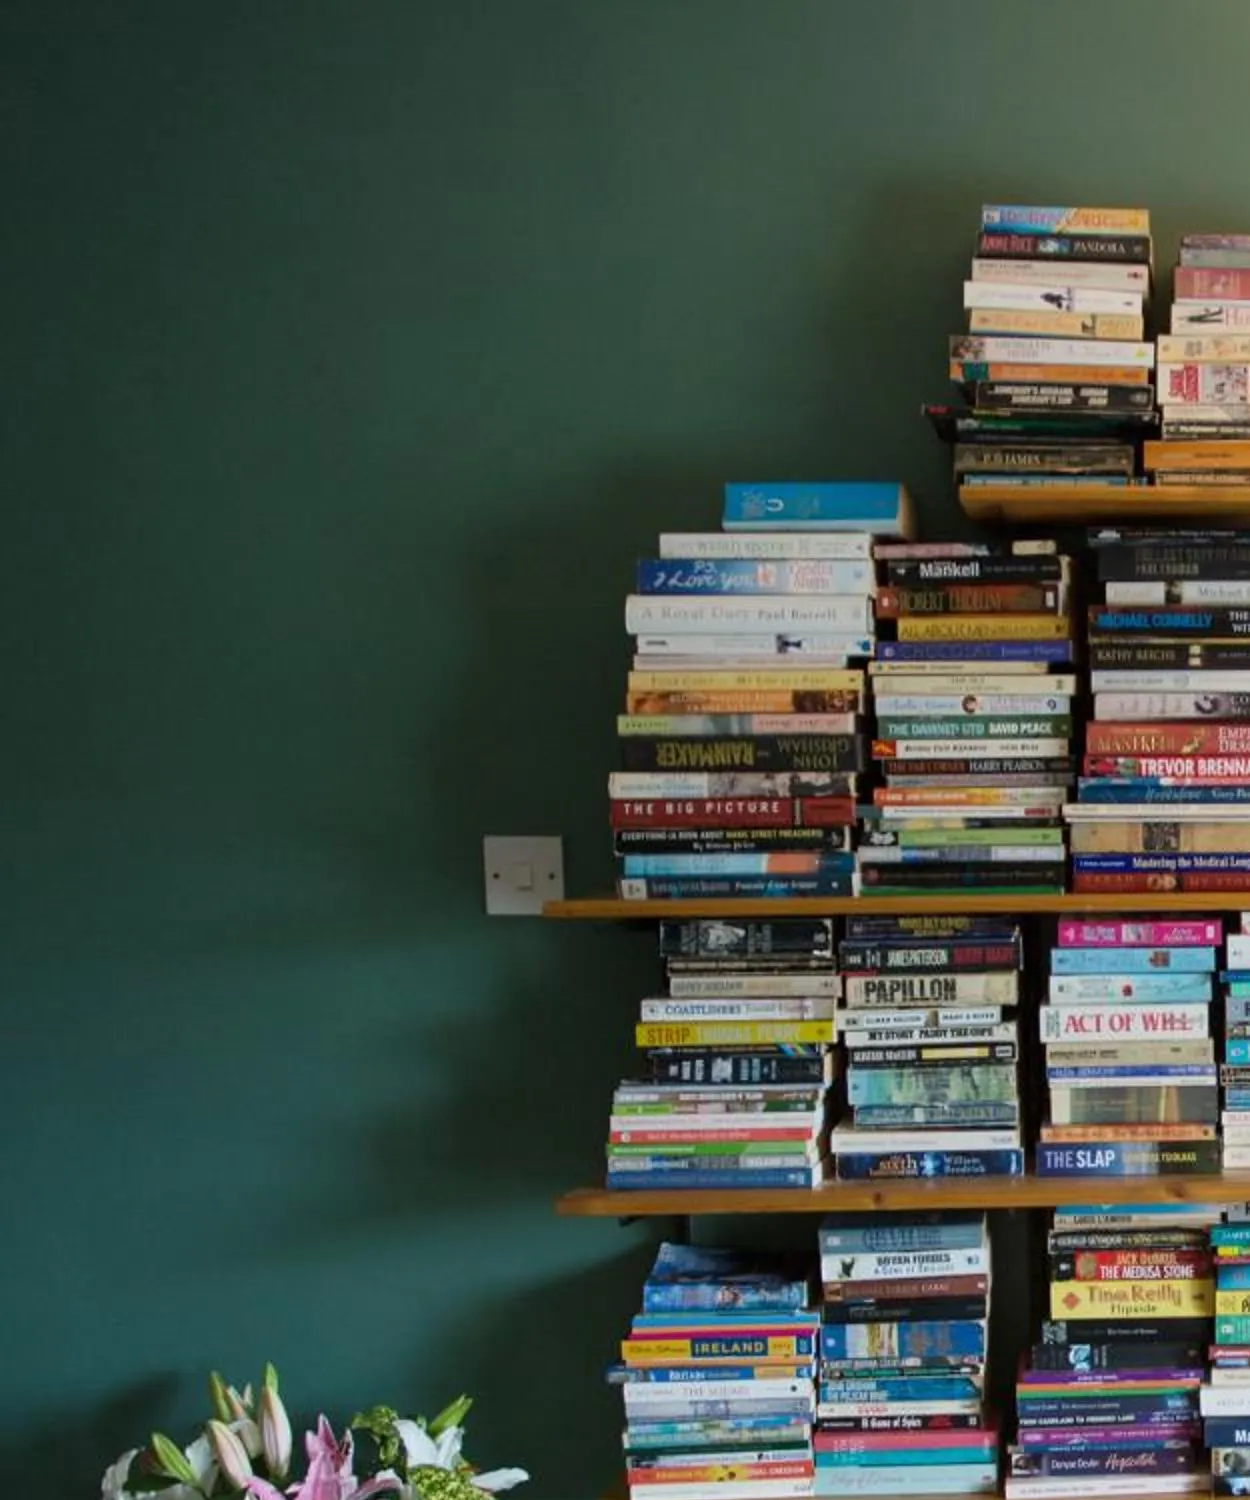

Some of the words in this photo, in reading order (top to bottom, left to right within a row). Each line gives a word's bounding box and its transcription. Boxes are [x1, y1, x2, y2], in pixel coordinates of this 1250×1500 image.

[1073, 242, 1127, 255] PANDORA
[919, 561, 980, 578] Mankell
[1229, 611, 1249, 621] THE
[656, 741, 755, 768] RAINMAKER
[1141, 758, 1196, 775] TREVOR
[623, 804, 654, 816] THE
[665, 802, 694, 815] BIG
[706, 801, 781, 814] PICTURE
[1132, 857, 1176, 871] Mastering
[864, 978, 957, 1003] PAPILLON
[1064, 1013, 1106, 1033] ACT
[1108, 1012, 1135, 1033] OF
[647, 1028, 690, 1045] STRIP
[1045, 1151, 1073, 1169] THE
[1076, 1150, 1116, 1168] SLAP
[1101, 1265, 1119, 1279] THE
[1122, 1264, 1161, 1279] MEDUSA
[1163, 1264, 1195, 1278] STONE
[1088, 1285, 1129, 1303] Tina
[1131, 1285, 1181, 1306] Reilly
[694, 1341, 764, 1356] IRELAND
